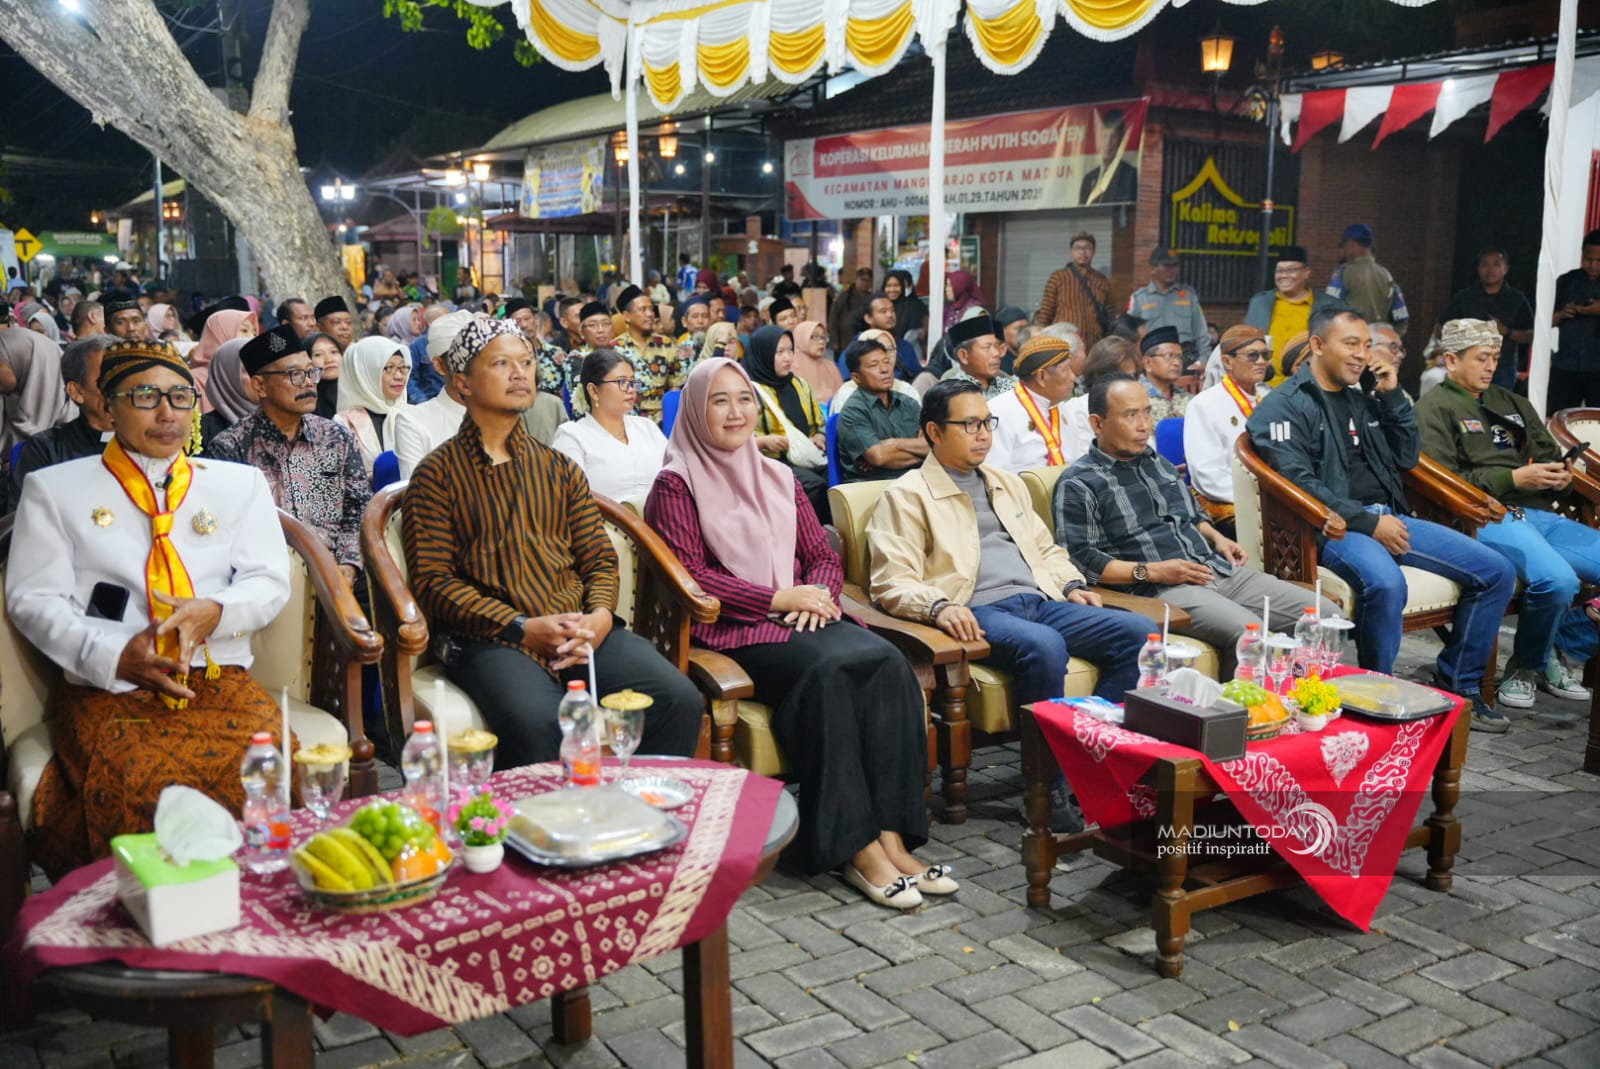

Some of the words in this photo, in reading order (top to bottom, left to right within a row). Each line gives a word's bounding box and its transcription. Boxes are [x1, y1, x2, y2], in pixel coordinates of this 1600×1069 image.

[820, 146, 869, 167] KOPERASI
[981, 131, 1019, 150] PUTIH
[1021, 124, 1086, 148] SOGATEN
[824, 180, 888, 196] KECAMATAN
[979, 170, 1014, 184] KOTA
[1022, 164, 1075, 181] MADUN
